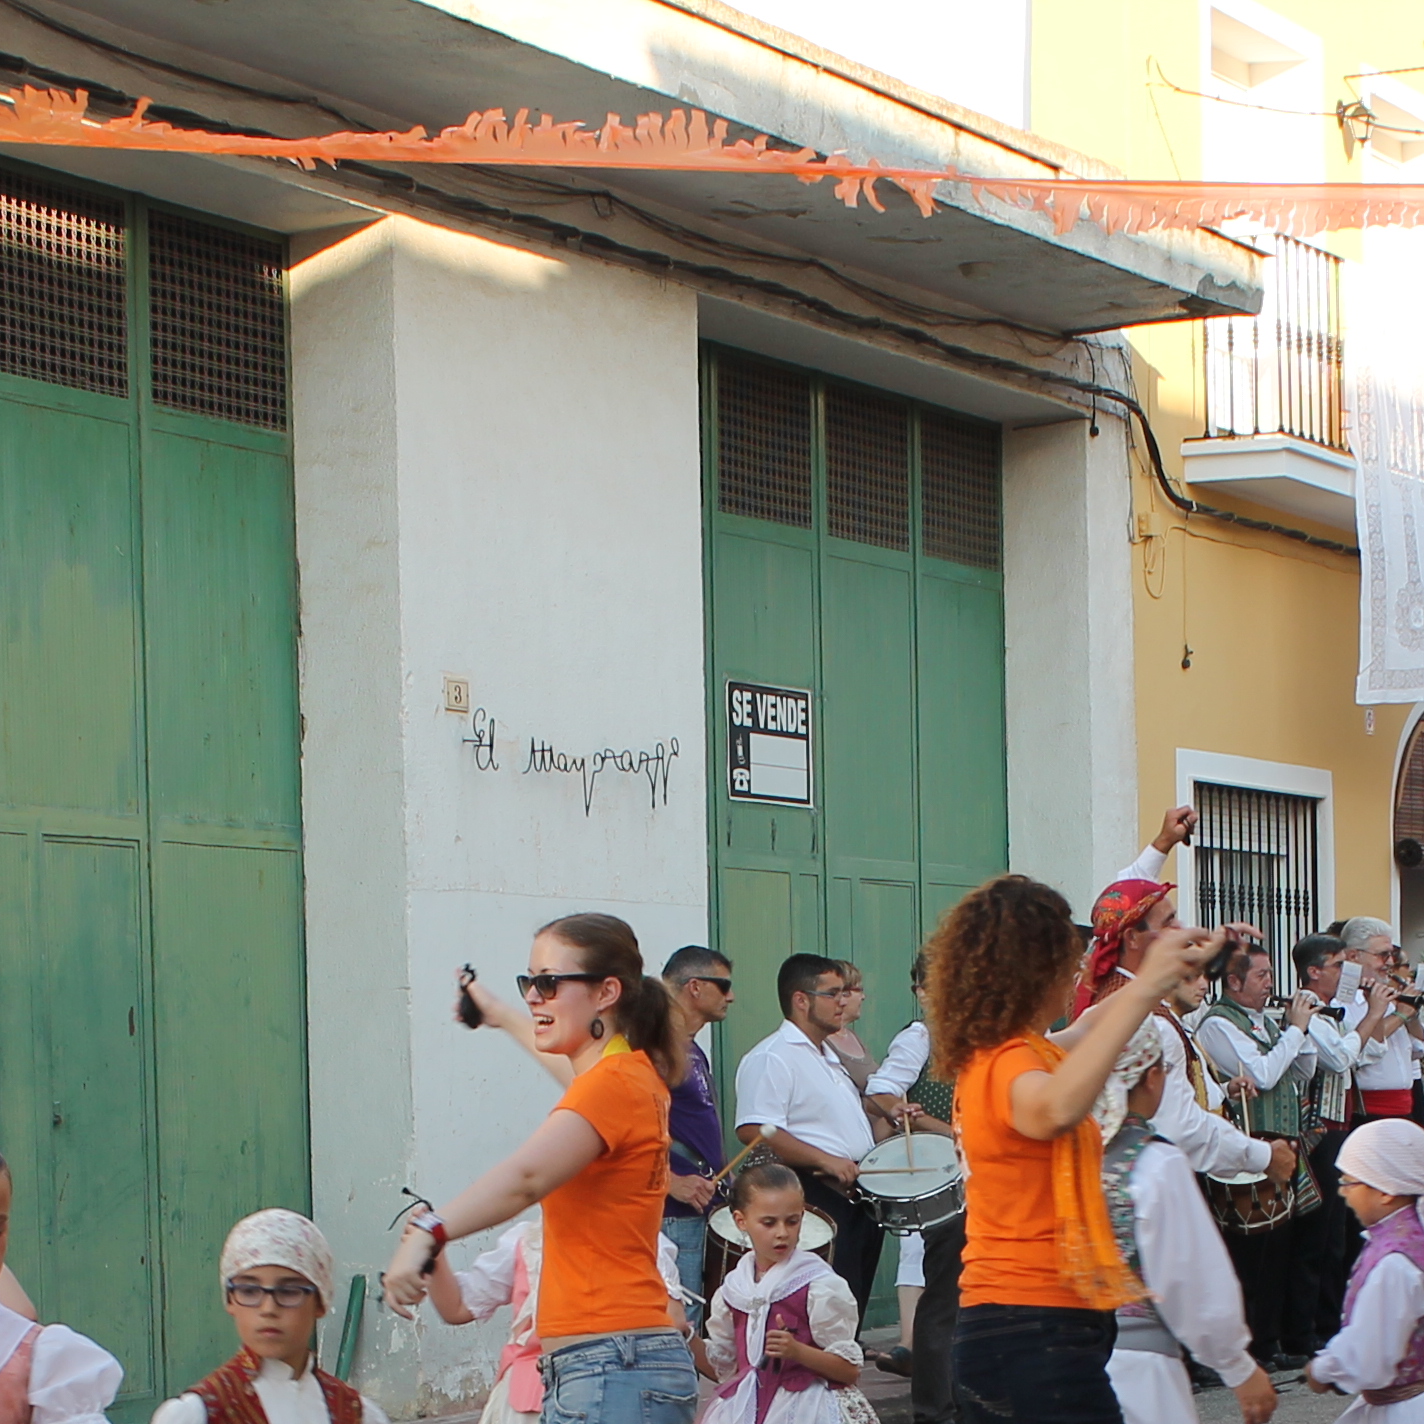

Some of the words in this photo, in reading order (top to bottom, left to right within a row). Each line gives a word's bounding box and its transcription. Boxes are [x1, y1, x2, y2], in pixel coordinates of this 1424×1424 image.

[454, 684, 463, 705] 3
[732, 689, 753, 727] SE
[756, 692, 807, 735] VENDE
[462, 707, 499, 772] El
